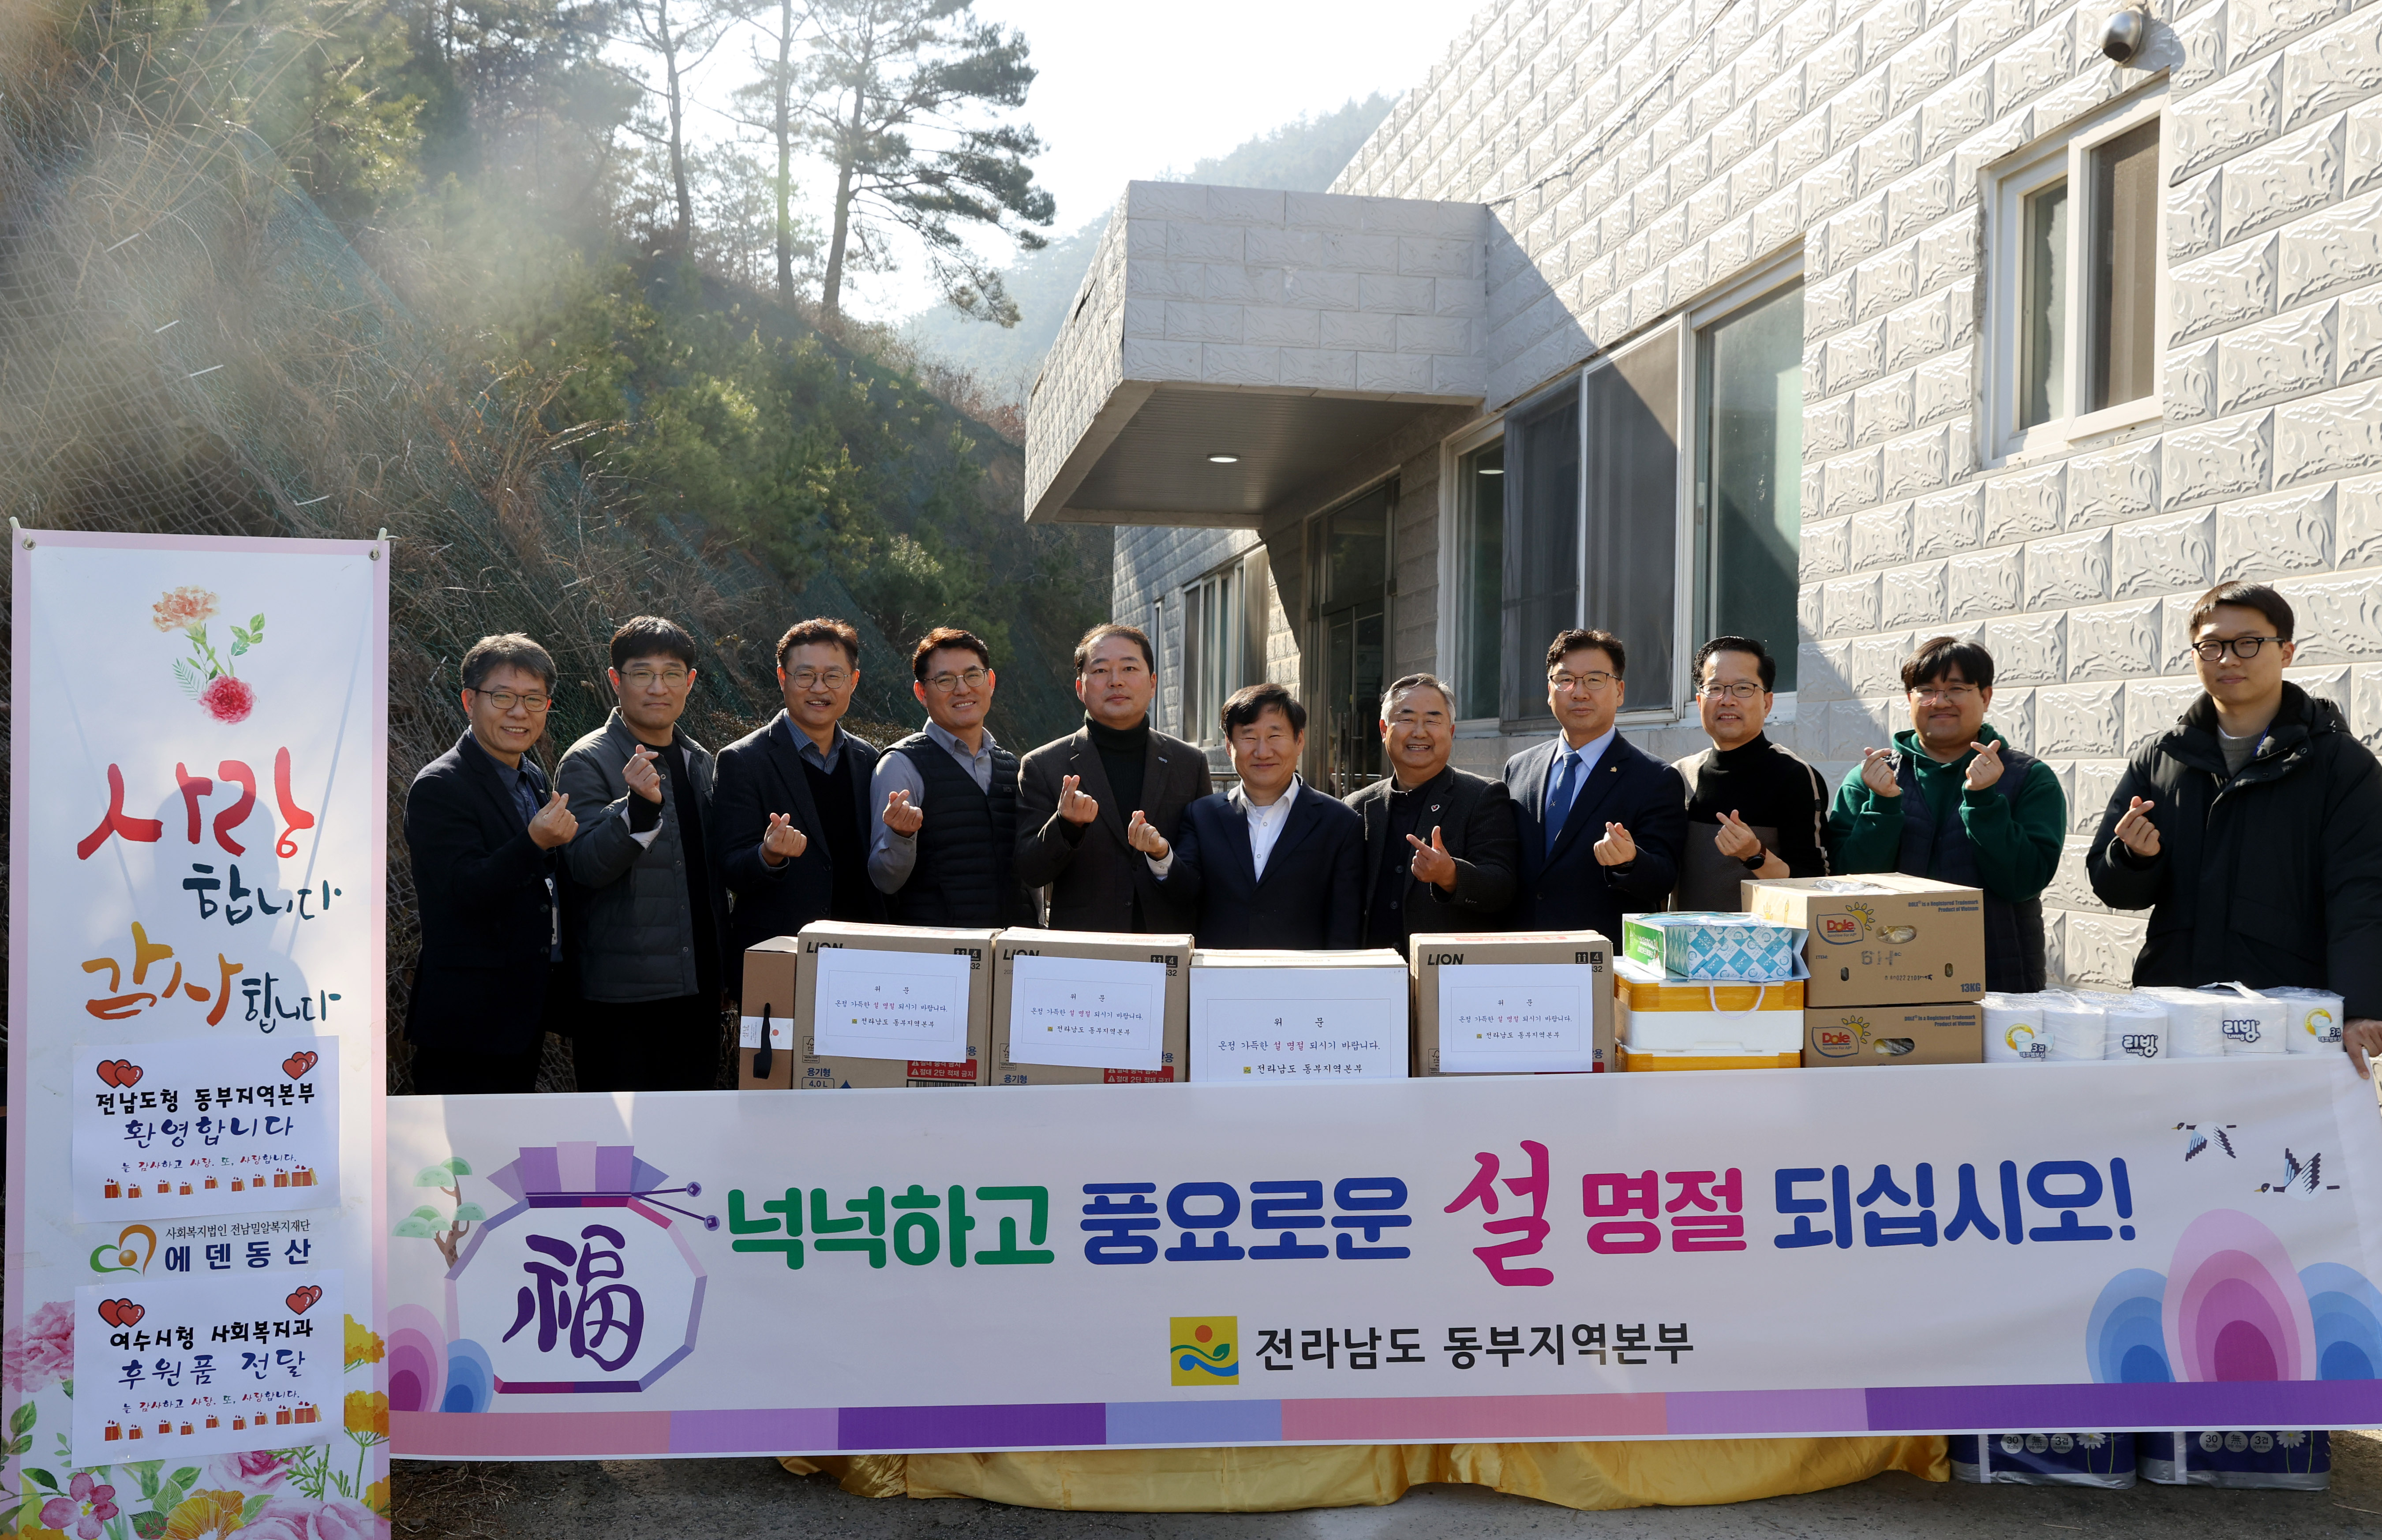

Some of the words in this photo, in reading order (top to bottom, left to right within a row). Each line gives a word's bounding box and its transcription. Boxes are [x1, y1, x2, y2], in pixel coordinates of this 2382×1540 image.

[77, 747, 314, 860] 사랑
[183, 863, 341, 926] 합니다
[1427, 953, 1464, 965] LION
[1960, 983, 1981, 993] 13KG
[893, 1019, 934, 1028] 동부지역본부
[1274, 1018, 1281, 1027] 위
[1315, 1017, 1324, 1028] 문
[1089, 1027, 1130, 1035] 동부지역본부
[2330, 1028, 2341, 1037] 3겹
[1218, 1041, 1235, 1050] 온정
[1241, 1041, 1268, 1050] 가득한
[1273, 1041, 1280, 1050] 설
[1287, 1041, 1303, 1051] 명절
[1310, 1041, 1335, 1050] 되시기
[1342, 1041, 1380, 1050] 바랍니다.
[2031, 1043, 2045, 1052] 3겹
[807, 1068, 831, 1077] 용기형
[1257, 1064, 1296, 1074] 전라남도
[1303, 1064, 1362, 1074] 동부지역본부
[1004, 1074, 1027, 1084] 용기형
[95, 1088, 178, 1115] 전남도청
[195, 1083, 315, 1111] 동부지역본부
[124, 1116, 293, 1148] 환영합니다
[139, 1160, 183, 1171] 감사하고
[190, 1158, 214, 1168] 사랑.
[240, 1154, 298, 1165] 사랑합니다.
[728, 1185, 1054, 1270] 넉넉하고
[1080, 1177, 1412, 1265] 풍요로운
[1444, 1140, 1554, 1286] 설
[1582, 1168, 1747, 1254] 명절
[1774, 1158, 2135, 1249] 되십시오!
[166, 1224, 227, 1240] 사회복지법인
[231, 1219, 311, 1235] 전남밀알복지재단
[502, 1224, 644, 1372] 福
[110, 1326, 194, 1352] 여수시청
[212, 1319, 313, 1344] 사회복지과
[1256, 1327, 1425, 1370] 전라남도
[1444, 1323, 1693, 1369] 동부지역본부
[119, 1355, 216, 1390] 후원품
[242, 1349, 305, 1379] 전달
[140, 1399, 184, 1412] 감사하고
[191, 1397, 216, 1406] 사랑.
[242, 1390, 301, 1402] 사랑합니다.
[2055, 1437, 2069, 1446] 3겹
[2206, 1435, 2218, 1443] 30
[2231, 1434, 2242, 1445] 無
[2255, 1436, 2269, 1445] 3겹
